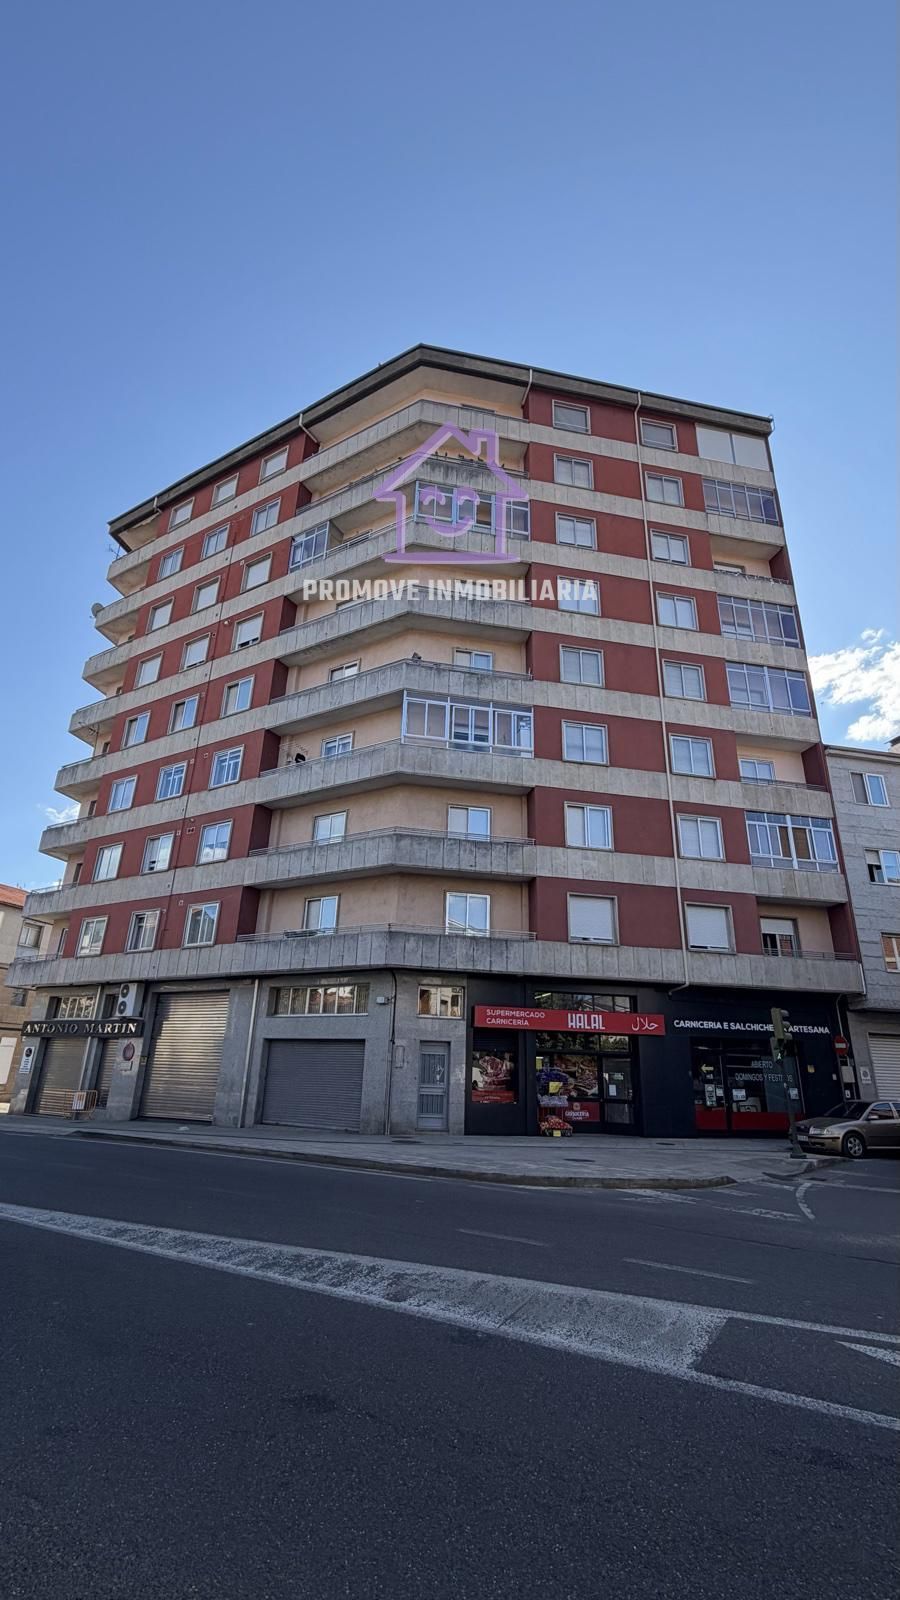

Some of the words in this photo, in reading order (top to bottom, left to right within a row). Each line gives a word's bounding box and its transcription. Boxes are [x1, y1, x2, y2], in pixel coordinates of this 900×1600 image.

[486, 1009, 545, 1019] SUPERMERCADO
[486, 1017, 529, 1026] CARNICERÍA
[568, 1013, 605, 1030] HALAL
[631, 1016, 659, 1031] حلال
[673, 1019, 723, 1030] CARNICERIA
[723, 1021, 729, 1029] E
[730, 1022, 787, 1032] SALCHICHE
[788, 1025, 830, 1034] ARTESANA
[24, 1023, 78, 1034] ANTONIO
[83, 1022, 138, 1034] MARTIN
[751, 1060, 773, 1069] ABIERTO
[735, 1072, 763, 1081] DOMINGOS
[763, 1073, 768, 1081] Y
[768, 1074, 793, 1082] FESTIOS
